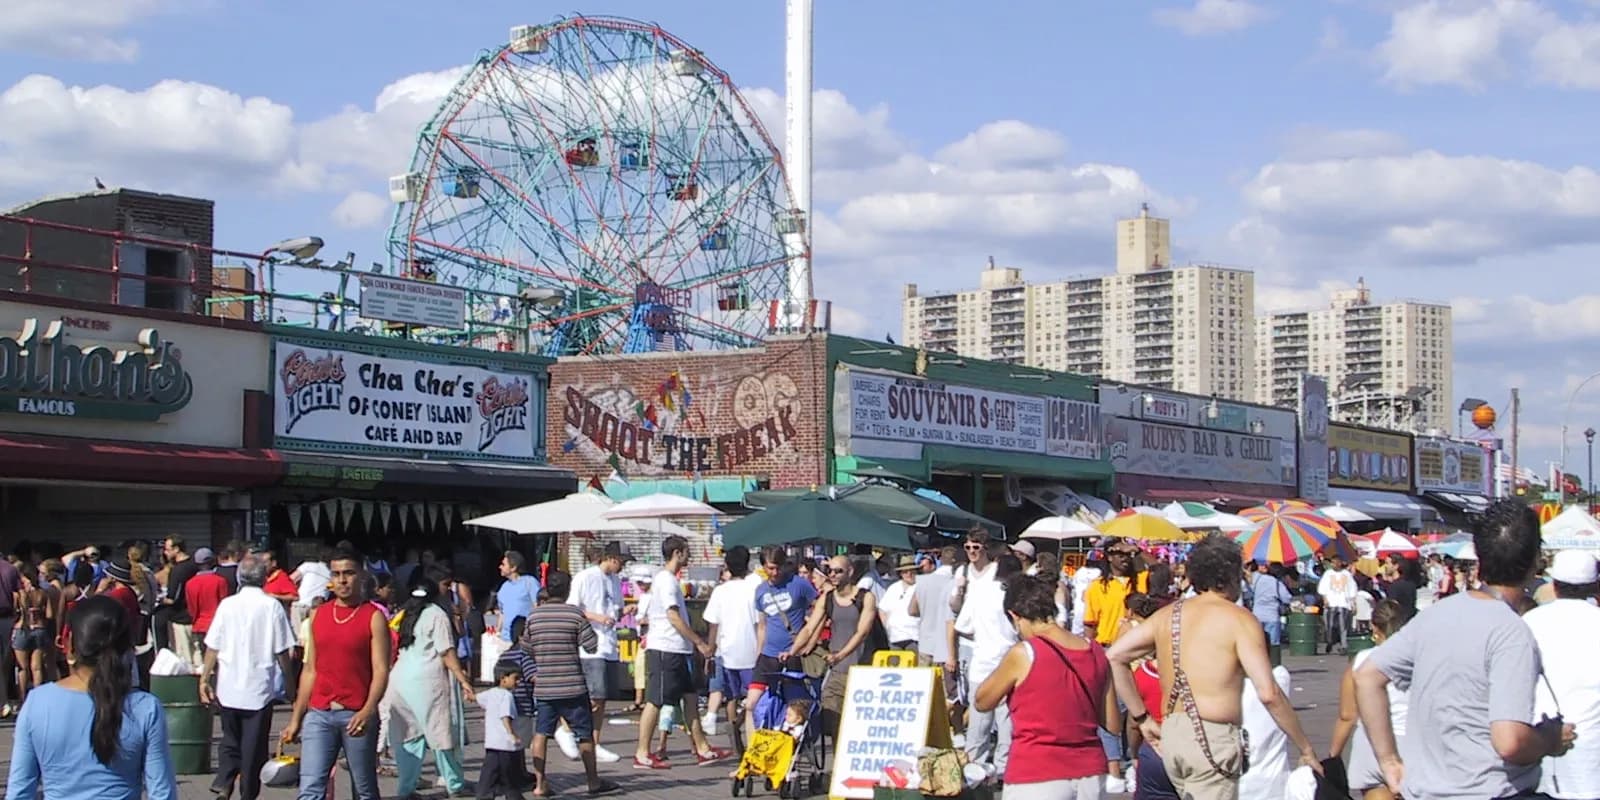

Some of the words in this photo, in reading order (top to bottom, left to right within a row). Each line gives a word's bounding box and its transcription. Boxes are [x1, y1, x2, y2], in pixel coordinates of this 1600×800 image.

[358, 363, 403, 391] Cha
[415, 369, 474, 399] Cha's
[18, 398, 76, 416] FAMOUS
[285, 384, 344, 434] LIGHT
[349, 396, 369, 416] OF
[372, 399, 421, 421] CONEY
[426, 403, 472, 424] ISLAND
[855, 407, 868, 420] FOR
[870, 408, 886, 421] RENT
[994, 398, 1015, 420] GIFT
[478, 405, 528, 451] LIGHT
[564, 385, 656, 465] SHOOT
[662, 434, 711, 471] THE
[716, 405, 797, 473] FREAK
[872, 423, 891, 436] TOYS
[899, 425, 915, 438] FILM
[995, 418, 1015, 432] SHOP
[1047, 398, 1065, 440] ICE
[1067, 402, 1100, 444] CREAM
[364, 423, 398, 444] CAFÉ
[403, 429, 433, 445] AND
[437, 431, 463, 446] BAR
[1141, 423, 1187, 453] RUBY'S
[1192, 430, 1219, 457] BAR
[1225, 435, 1234, 458] &
[1239, 436, 1273, 462] GRILL
[1328, 446, 1409, 482] PLAYLAND
[879, 672, 903, 687] 2
[852, 689, 925, 705] GO-KART
[855, 706, 918, 723] TRACKS
[867, 724, 899, 738] and
[847, 740, 915, 757] BATTING
